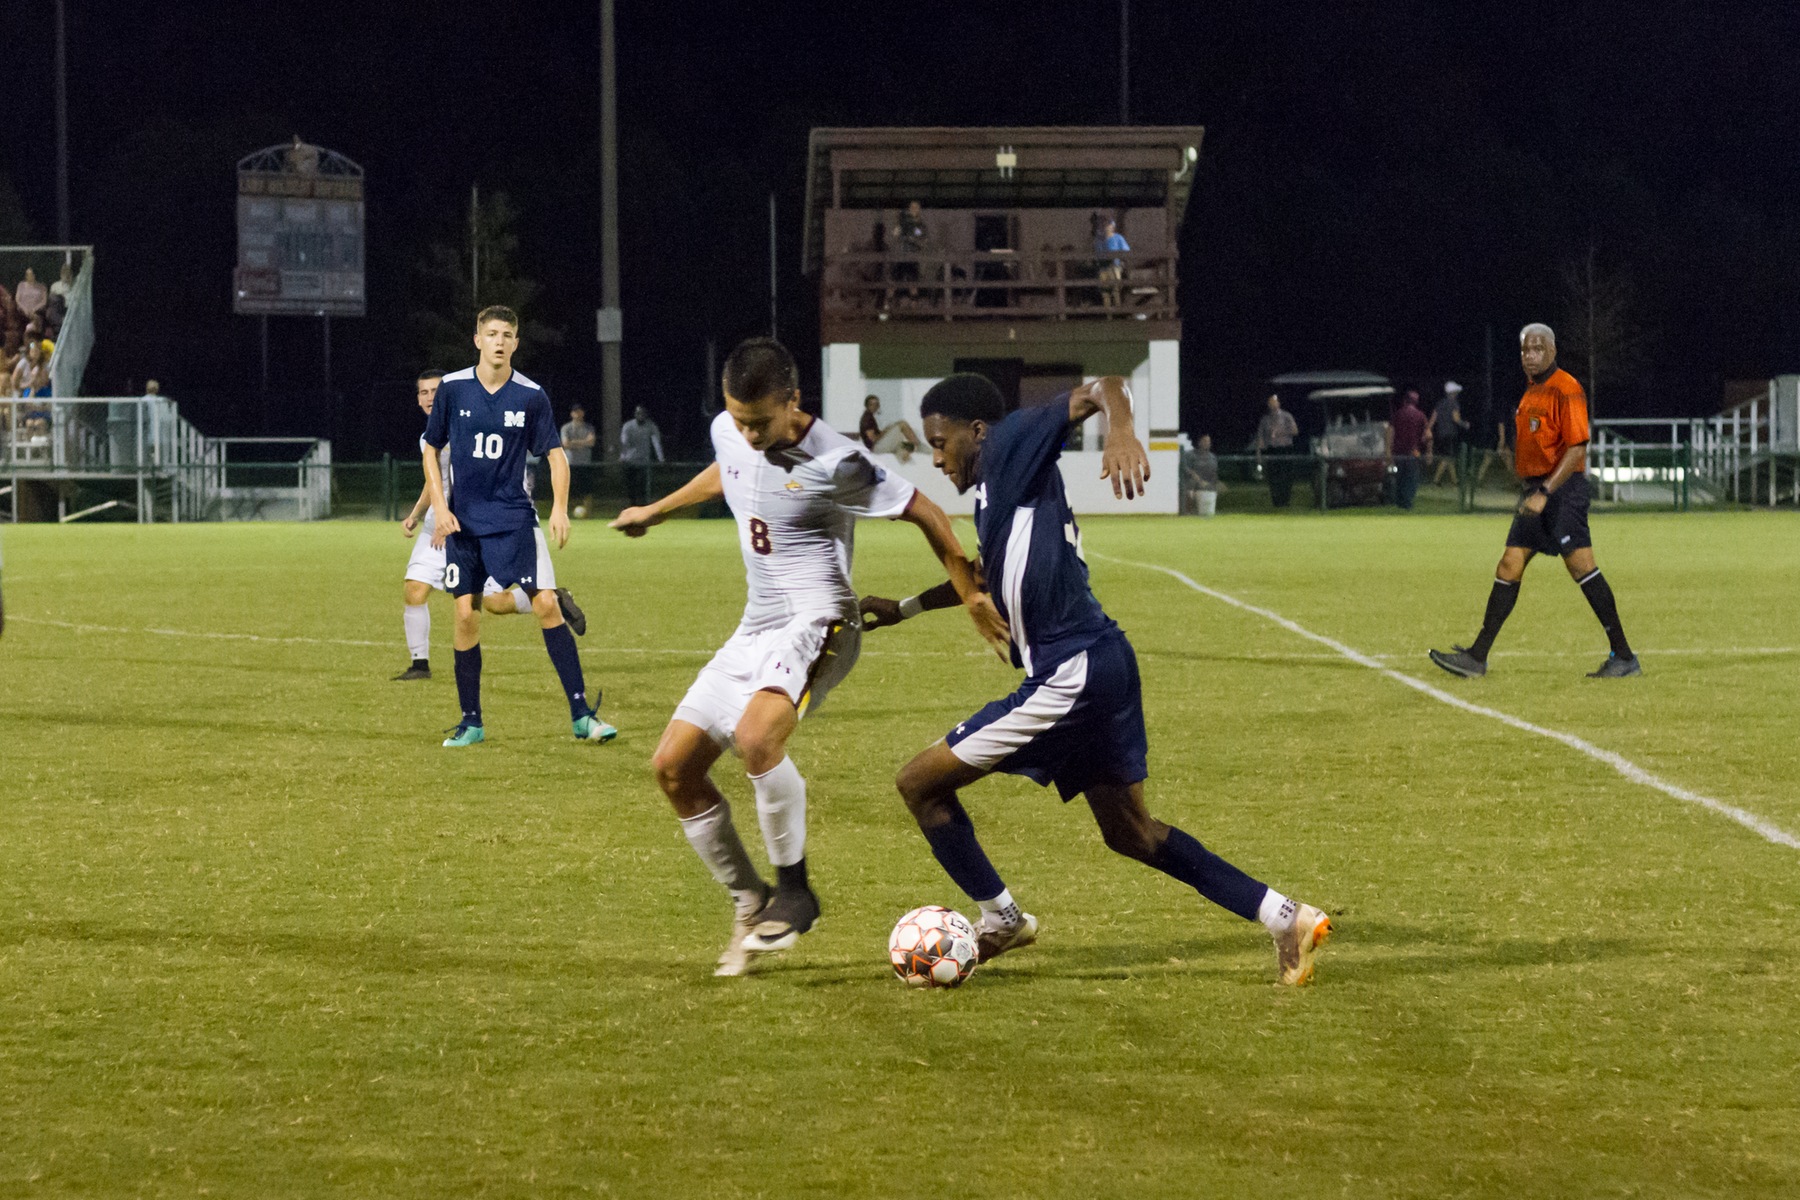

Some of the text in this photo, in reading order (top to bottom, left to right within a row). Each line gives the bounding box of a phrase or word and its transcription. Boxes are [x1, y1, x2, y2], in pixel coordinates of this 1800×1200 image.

[504, 411, 525, 427] M
[473, 432, 503, 459] 10
[750, 517, 772, 555] 8
